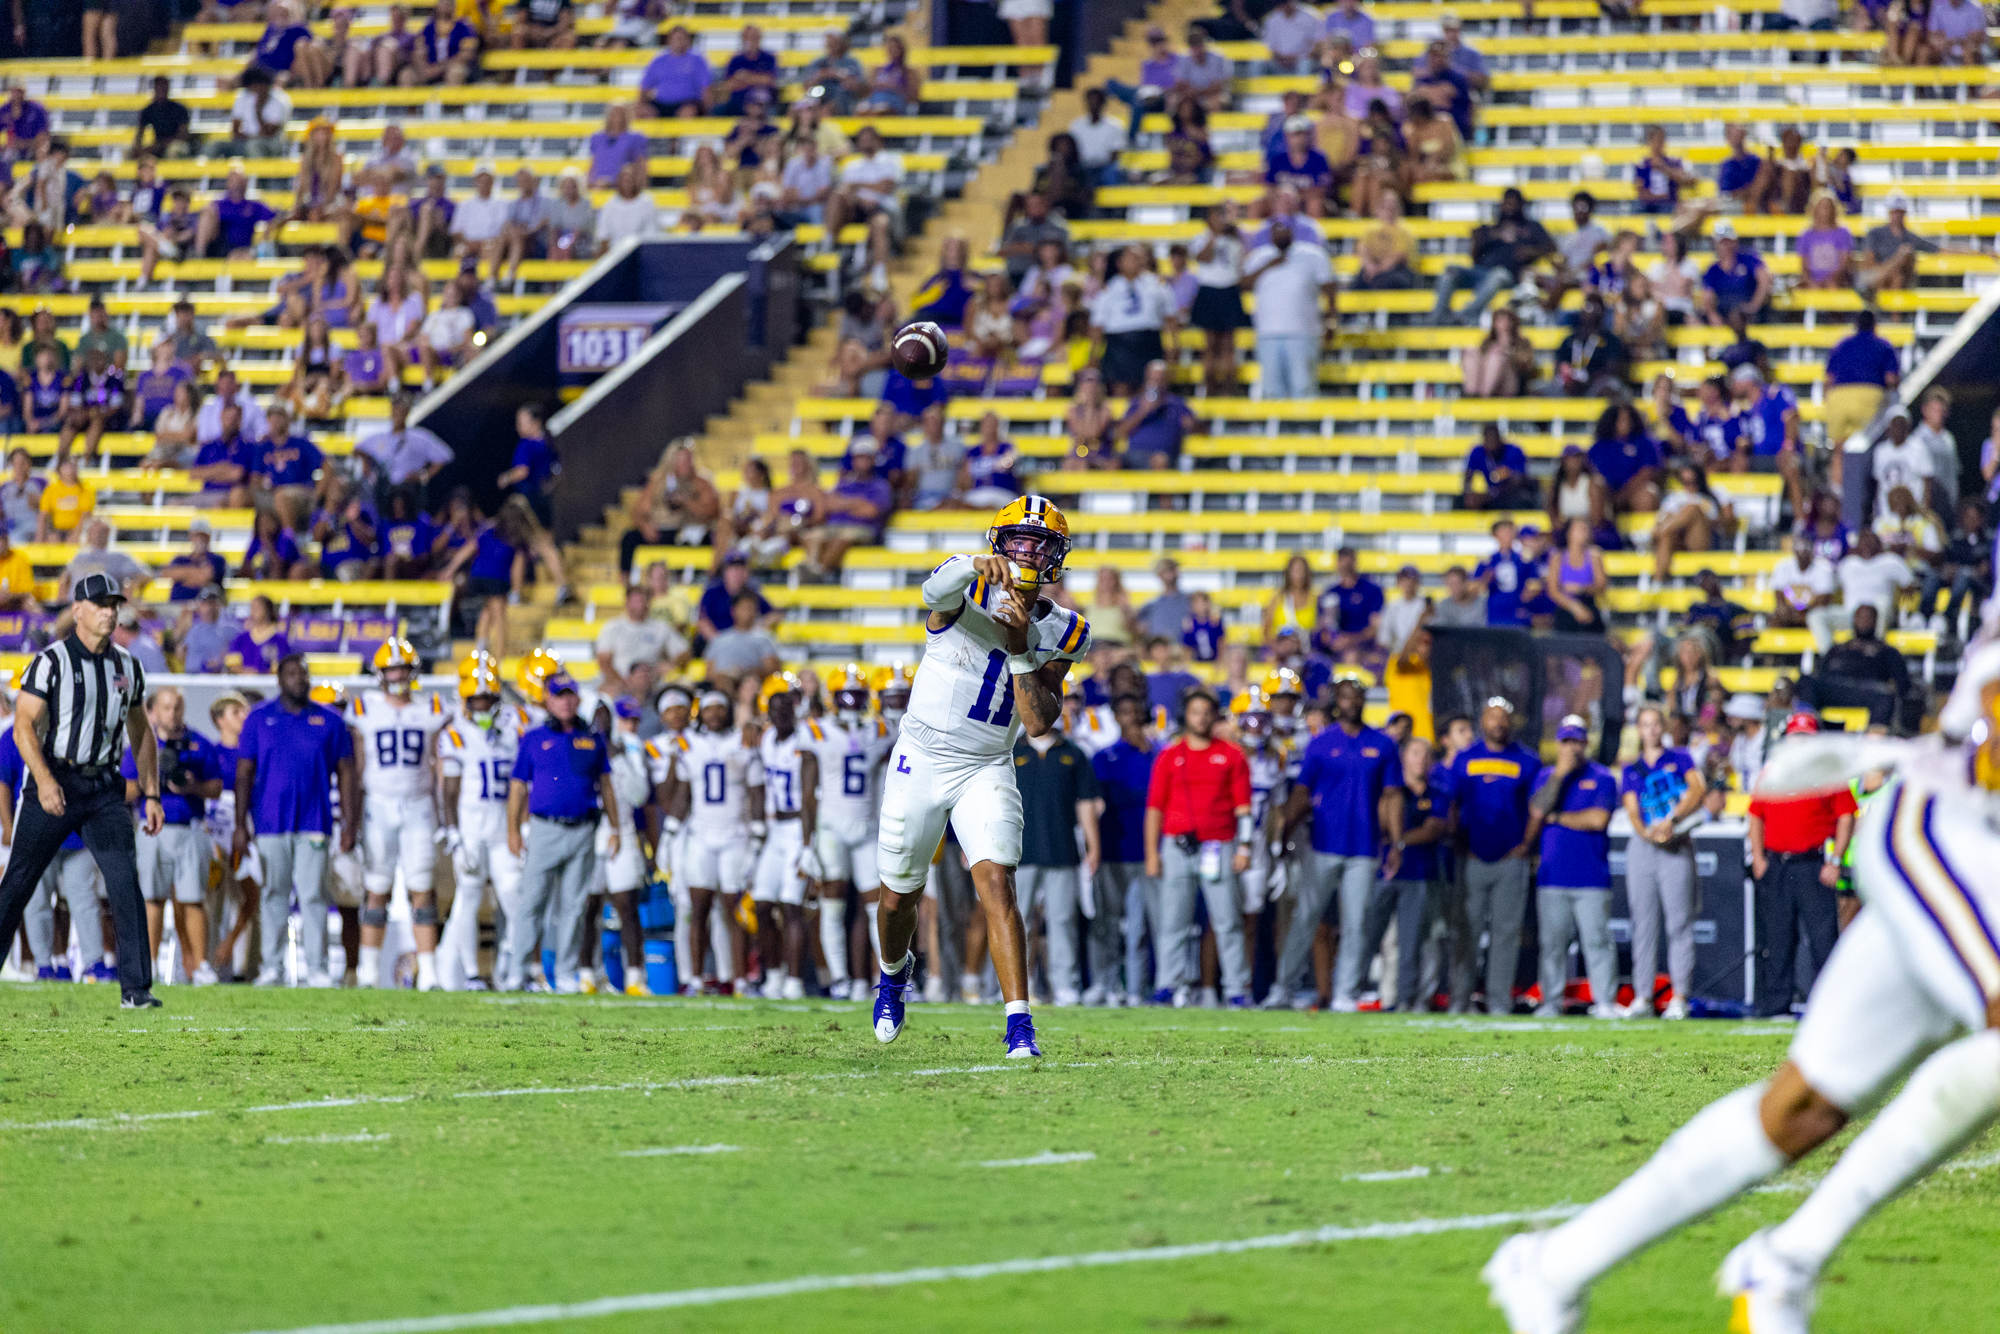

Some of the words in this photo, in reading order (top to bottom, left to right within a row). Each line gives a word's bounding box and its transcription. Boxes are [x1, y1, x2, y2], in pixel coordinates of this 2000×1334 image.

[1026, 518, 1042, 526] LSU
[966, 648, 1014, 728] 11
[376, 729, 425, 767] 89
[897, 754, 912, 775] L
[479, 759, 512, 800] 15
[704, 763, 725, 804] 0
[844, 754, 866, 795] 6
